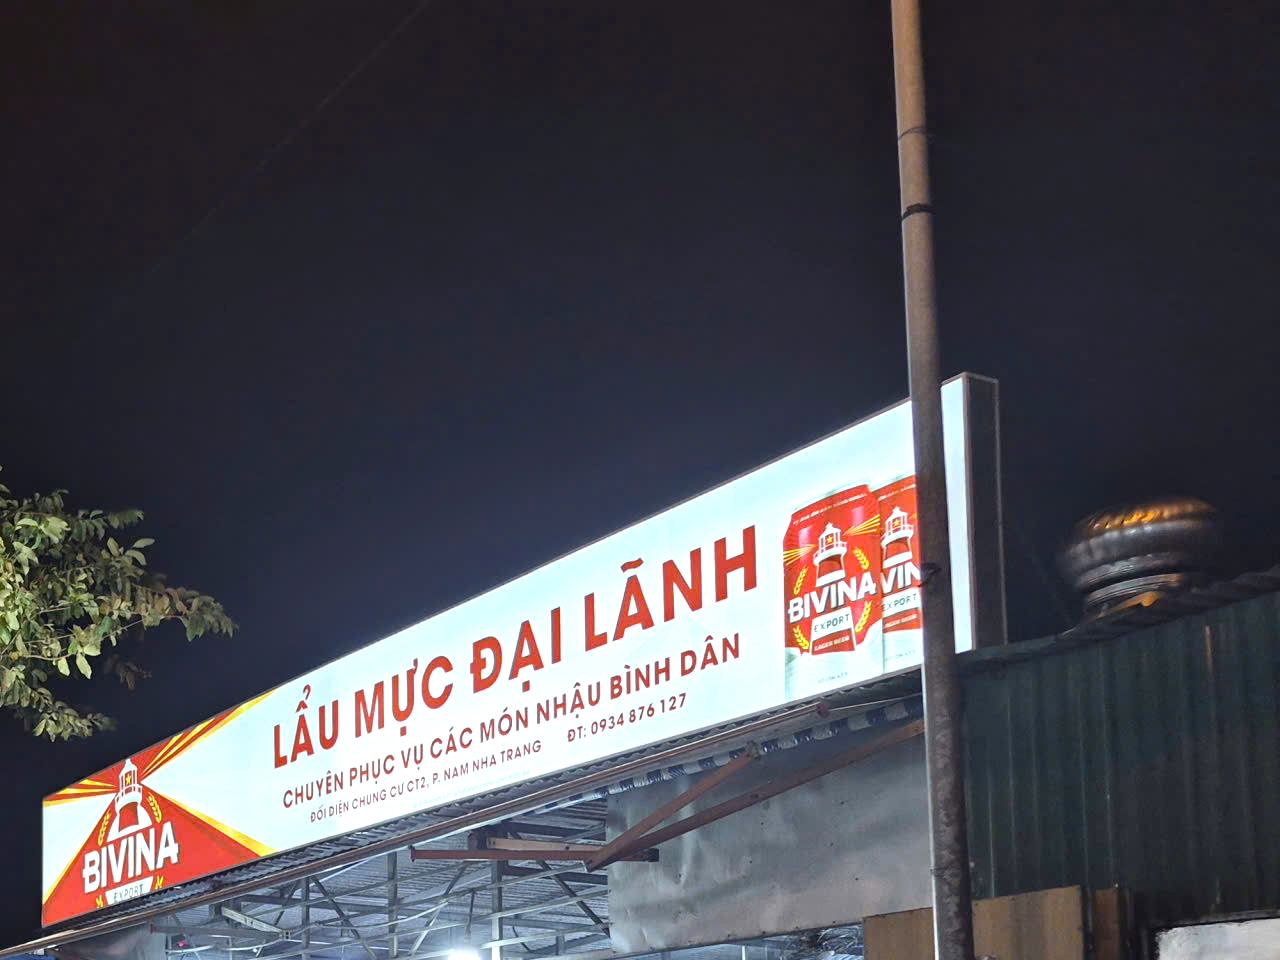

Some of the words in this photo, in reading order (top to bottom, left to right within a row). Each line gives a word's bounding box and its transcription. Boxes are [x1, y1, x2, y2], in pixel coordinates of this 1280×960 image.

[788, 571, 877, 624] BIVINA
[813, 613, 850, 633] EXPORT
[273, 684, 339, 769] LẨU
[354, 655, 454, 739] MỰC
[469, 606, 562, 694] ĐẠI
[584, 524, 757, 652] LÃNH
[283, 770, 344, 809] CHUYÊN
[349, 754, 395, 787] PHỤC
[401, 743, 424, 771] VỤ
[429, 726, 473, 759] CÁC
[479, 706, 529, 743] MÓN
[536, 681, 601, 724] NHẬU
[610, 657, 670, 700] BÌNH
[680, 632, 739, 677] DÂN
[567, 726, 587, 742] ĐT:
[591, 713, 625, 735] 0934
[628, 703, 655, 723] 876
[660, 692, 687, 714] 127
[310, 804, 327, 823] ĐỐI
[352, 789, 387, 810] CHUNG
[390, 782, 405, 798] CƯ
[432, 772, 441, 785] P.
[443, 762, 469, 782] NAM
[472, 754, 497, 773] NHA
[500, 740, 542, 763] TRANG
[82, 821, 180, 894] BIVINA
[113, 884, 144, 901] EXPORT
